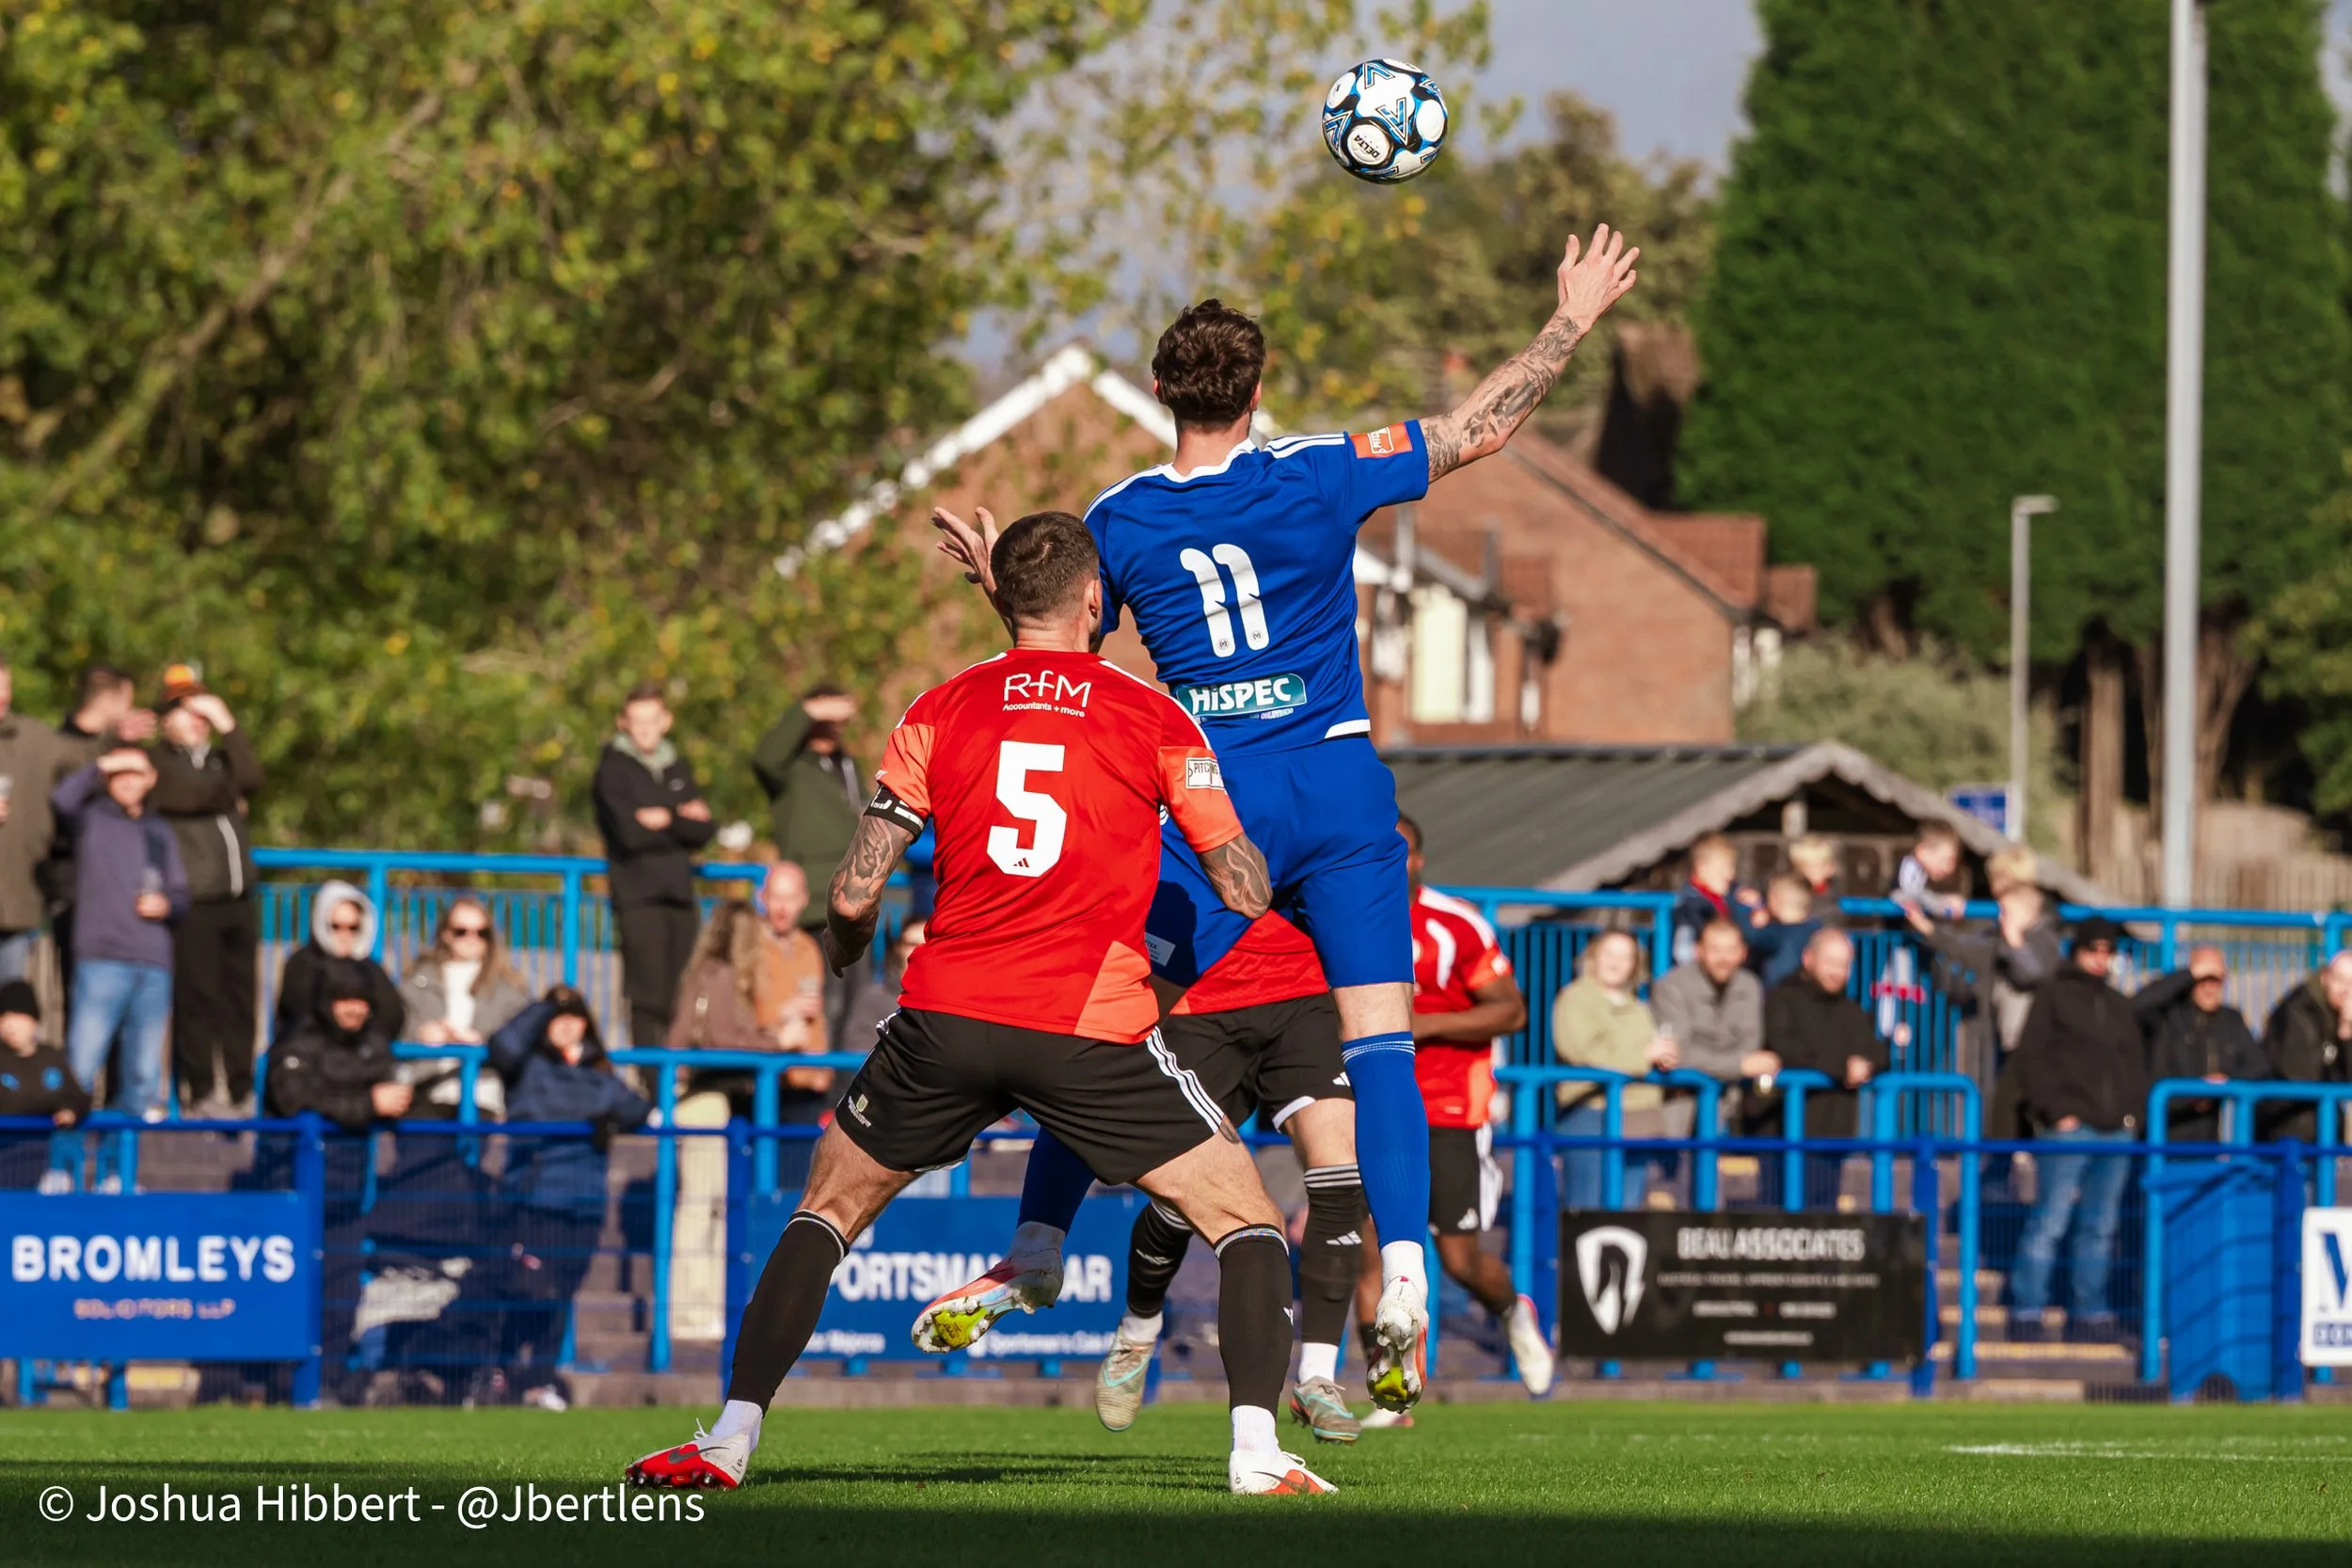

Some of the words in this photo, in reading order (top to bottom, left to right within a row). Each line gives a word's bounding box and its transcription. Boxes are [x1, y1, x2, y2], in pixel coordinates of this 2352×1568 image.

[1354, 135, 1380, 158] DELTA
[1179, 543, 1270, 657] 11
[1002, 701, 1053, 712] Accountants
[1059, 705, 1086, 718] more
[1003, 670, 1092, 707] RfM
[986, 739, 1068, 878] 5
[11, 1234, 295, 1283] BROMLEYS
[1058, 1254, 1113, 1304] AR
